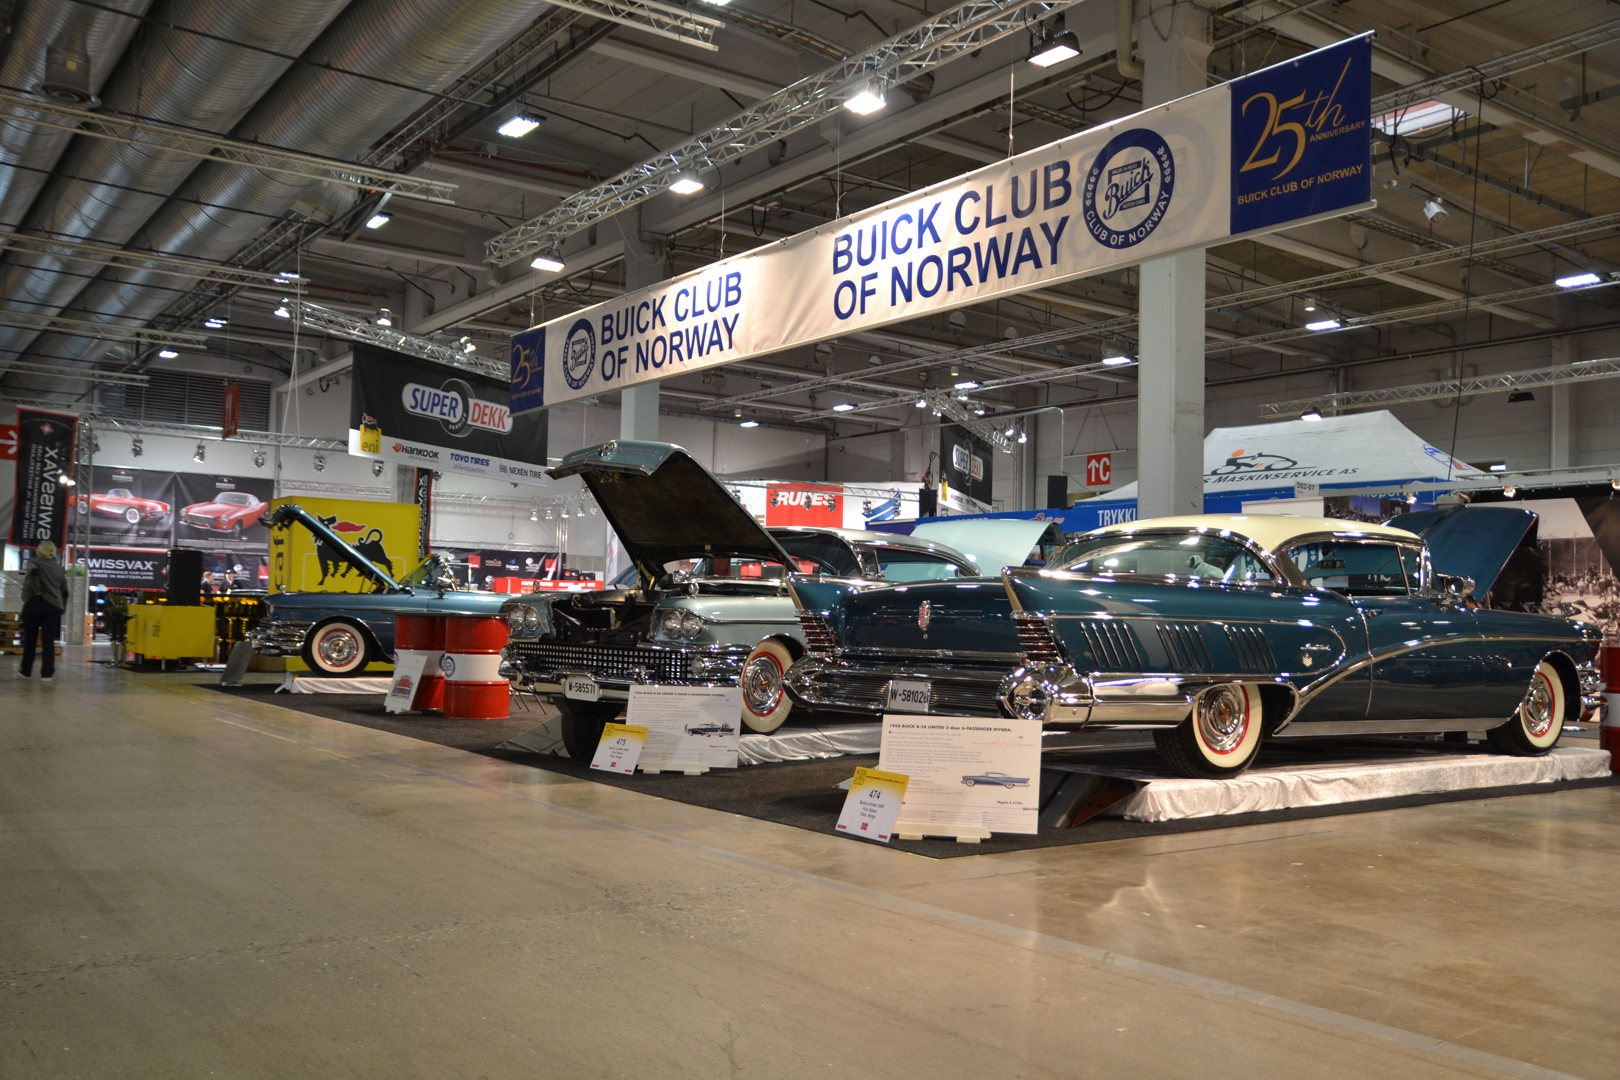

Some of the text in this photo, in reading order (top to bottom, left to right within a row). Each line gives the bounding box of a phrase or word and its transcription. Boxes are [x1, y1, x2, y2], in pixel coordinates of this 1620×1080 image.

[1239, 57, 1352, 181] 25th
[1309, 119, 1366, 142] ANNIVERSARY
[1102, 156, 1154, 220] Buick
[1237, 164, 1364, 205] BUICK CLUB OF NORWAY
[833, 160, 1072, 275] BUICK CLUB
[1086, 190, 1169, 246] CLUB OF NORWAY
[833, 215, 1071, 320] OF NORWAY
[601, 271, 742, 346] BUICK CLUB
[601, 313, 740, 382] OF NORWAY
[410, 387, 458, 419] SUPER
[470, 402, 508, 430] DEKK
[448, 412, 468, 430] SERVICE
[362, 439, 379, 454] eni
[450, 452, 470, 464] TOYO
[470, 456, 490, 467] TIRES
[509, 466, 542, 479] NEXEN TIRE
[1099, 457, 1110, 481] C
[1210, 468, 1339, 485] MASKINSERVICE
[1342, 467, 1360, 475] AS
[868, 789, 882, 800] 474
